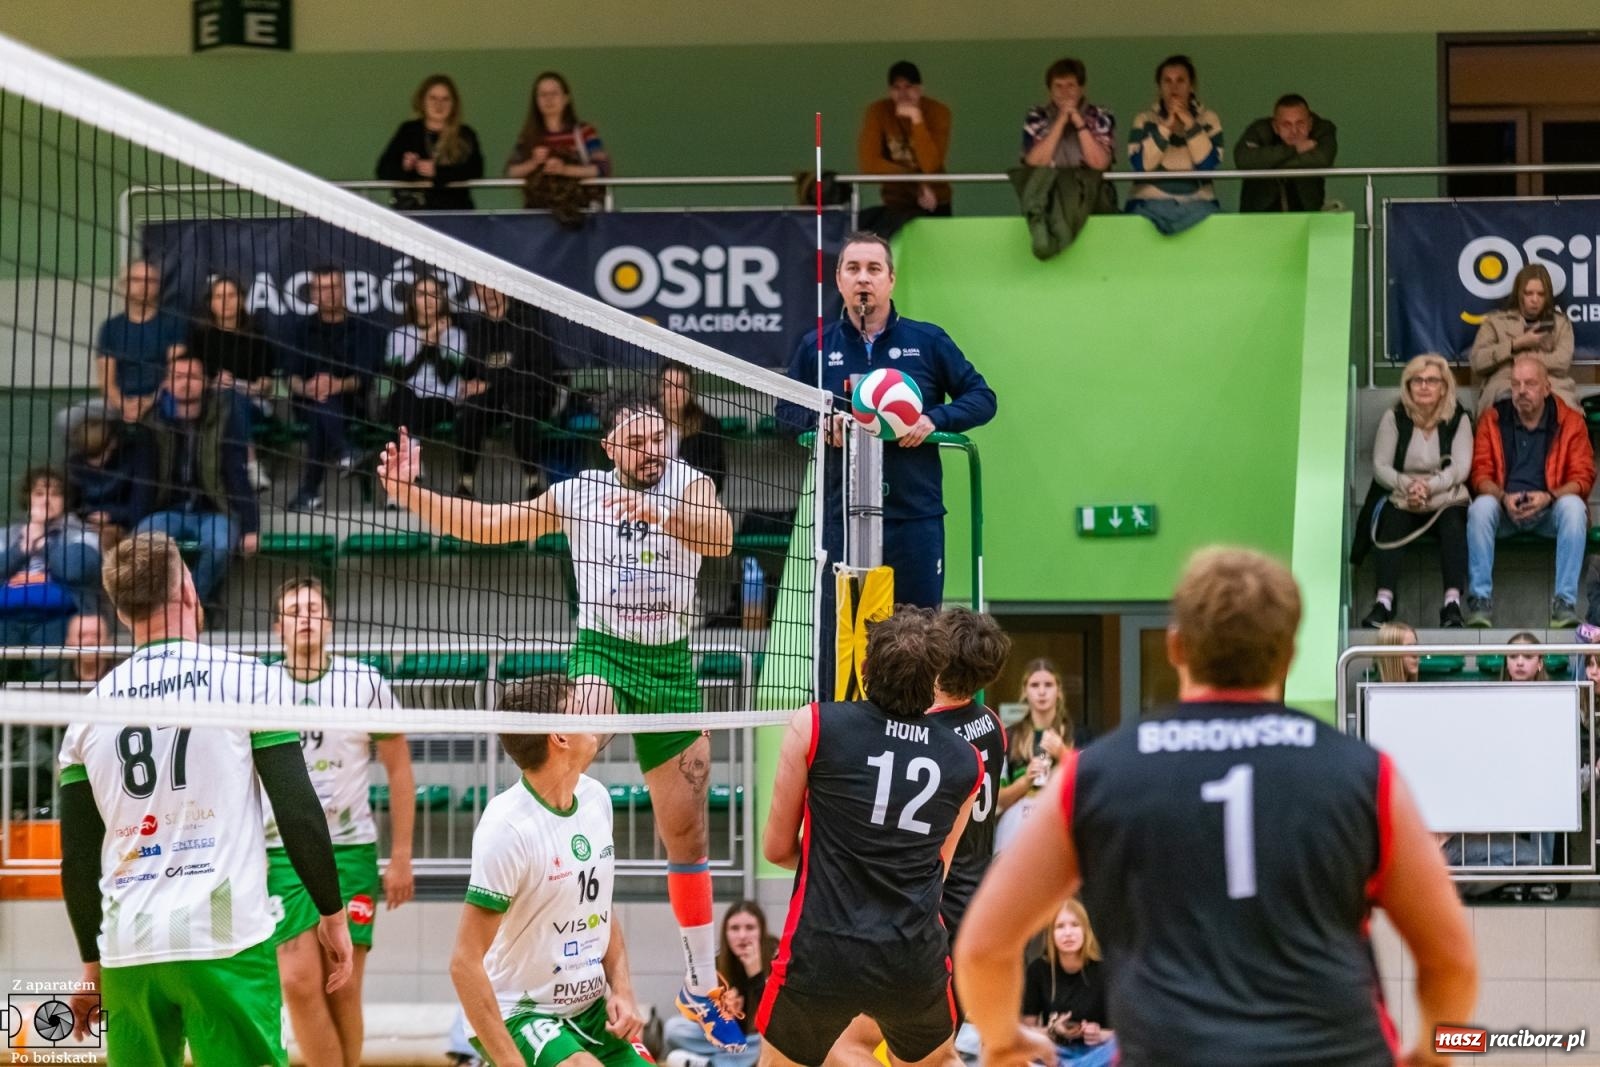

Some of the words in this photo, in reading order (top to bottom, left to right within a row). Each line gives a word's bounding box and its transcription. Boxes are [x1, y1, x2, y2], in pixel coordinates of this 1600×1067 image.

[200, 13, 219, 45] E
[244, 12, 277, 44] E
[595, 245, 782, 309] OSiR
[1458, 233, 1600, 299] OSi
[668, 309, 783, 332] RACIBÓRZ
[618, 520, 649, 541] 49
[885, 719, 929, 745] HOIM
[1138, 714, 1317, 754] BOROWSKI
[116, 725, 192, 800] 87
[867, 750, 941, 835] 12
[1201, 763, 1257, 899] 1
[578, 866, 600, 904] 16
[553, 911, 608, 934] VISON
[553, 976, 603, 997] PIVEXIN
